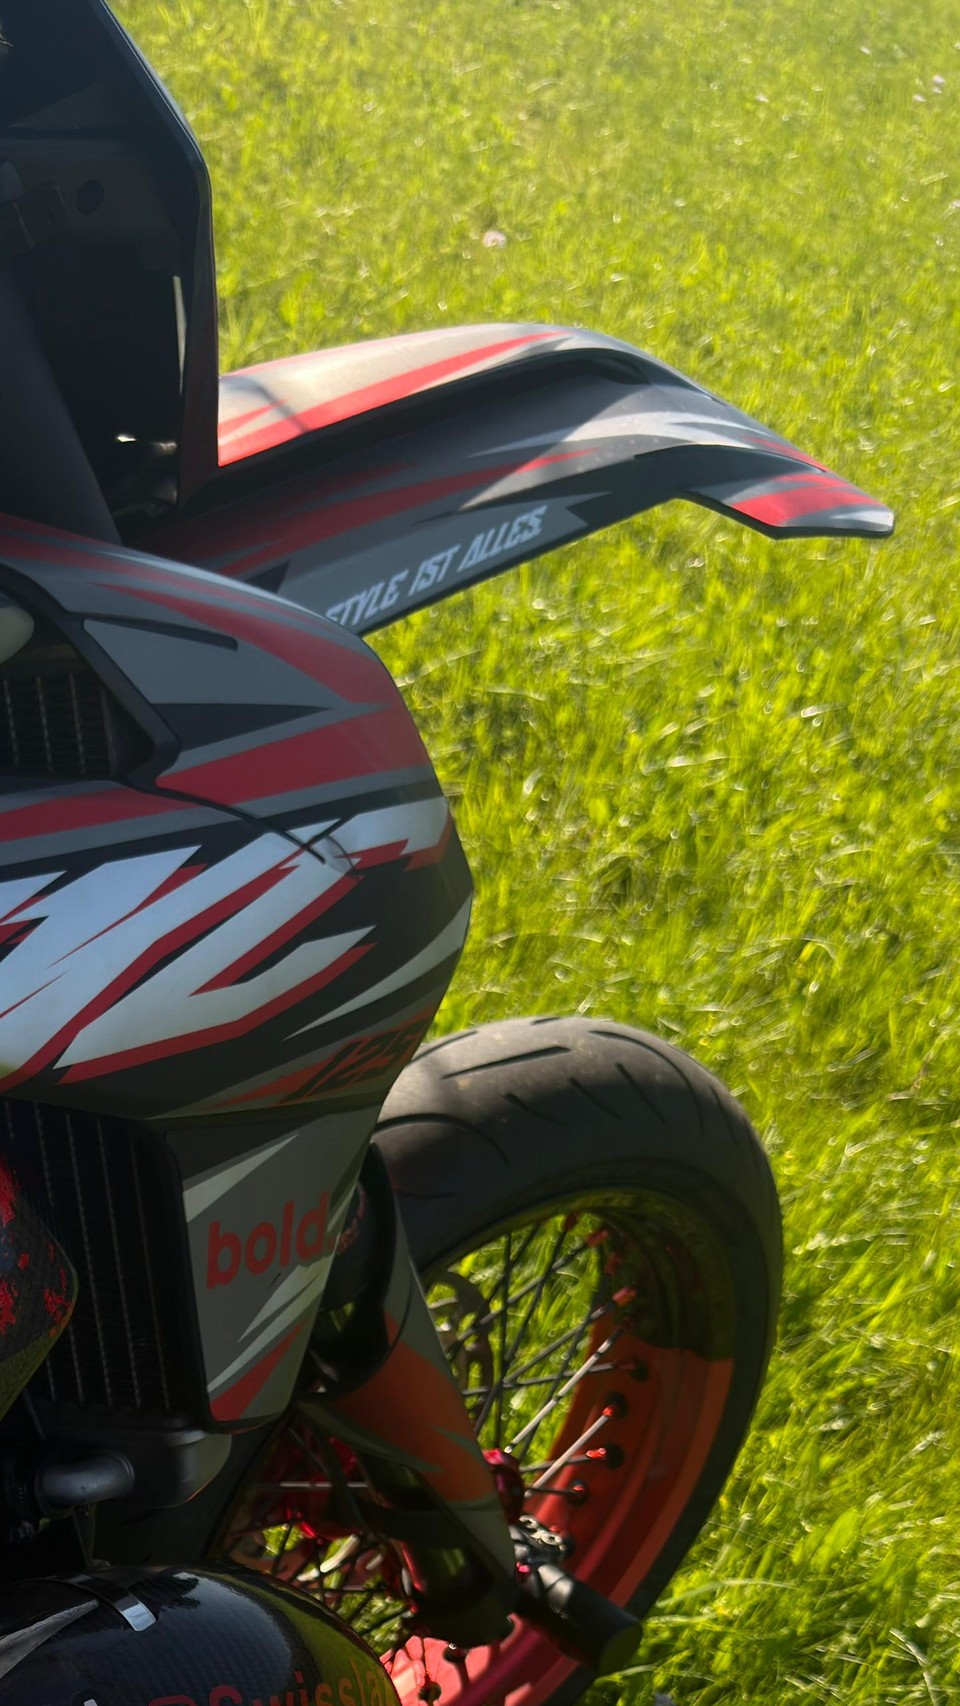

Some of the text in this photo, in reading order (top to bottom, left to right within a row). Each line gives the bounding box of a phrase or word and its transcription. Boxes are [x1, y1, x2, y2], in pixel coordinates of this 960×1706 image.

[325, 505, 548, 627] STYLE IST ALLES
[206, 1191, 336, 1289] bold.
